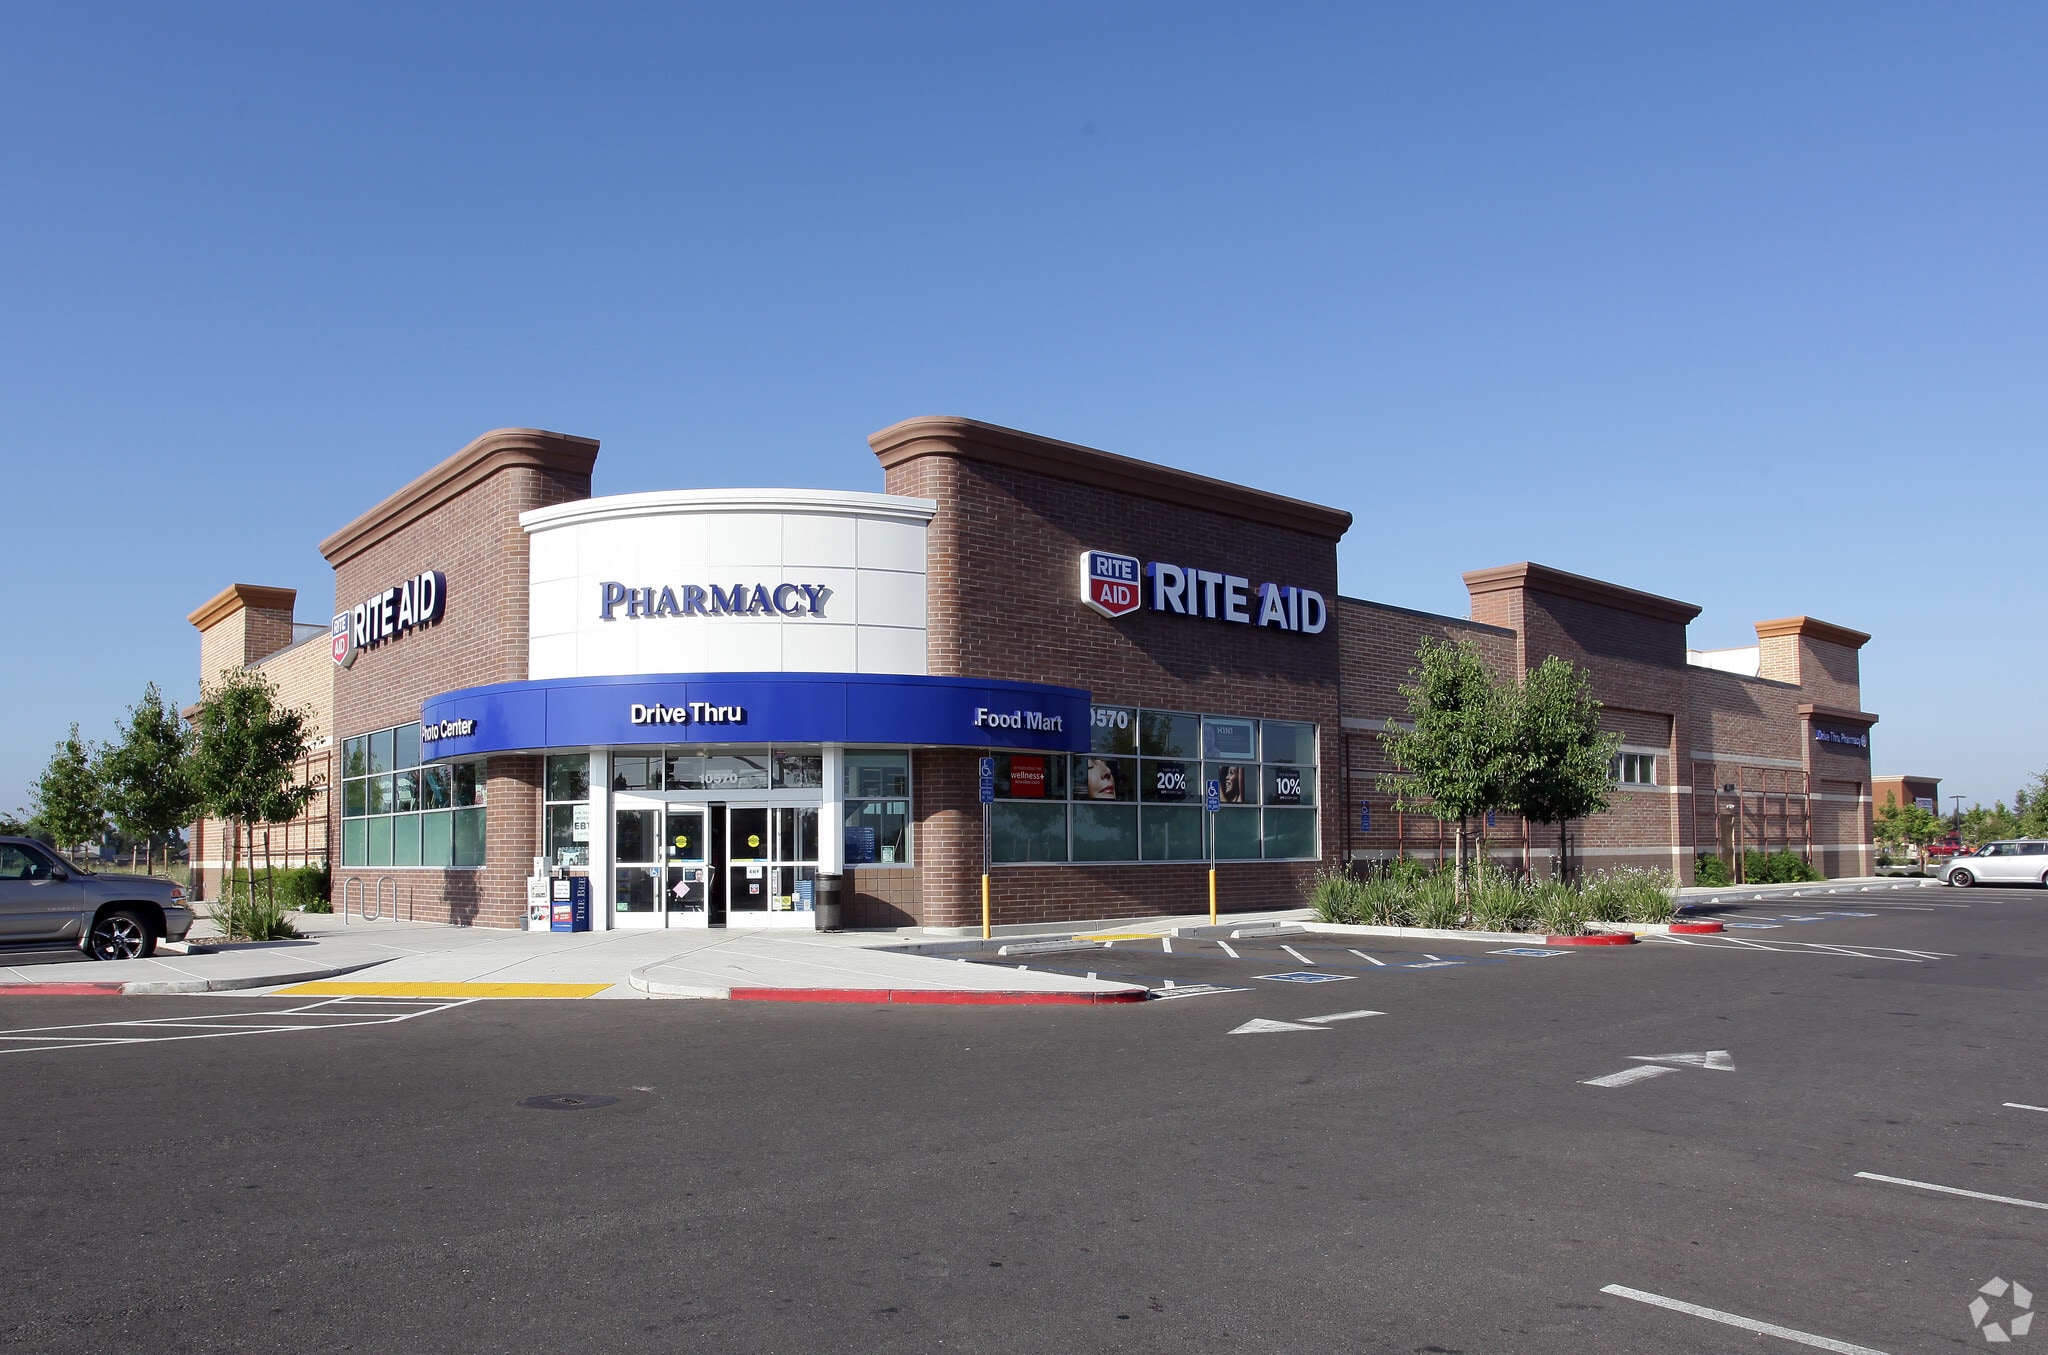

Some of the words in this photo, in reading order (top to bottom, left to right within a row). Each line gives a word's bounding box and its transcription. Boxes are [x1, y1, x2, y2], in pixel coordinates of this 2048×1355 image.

[1096, 556, 1132, 580] RITE
[598, 580, 827, 620] PHARMACY
[1100, 583, 1131, 606] AID
[1151, 562, 1250, 624] RITE
[1259, 582, 1327, 635] AID
[353, 587, 394, 649] RITE
[398, 570, 436, 630] AID
[334, 614, 347, 635] RITE
[334, 637, 346, 657] AID
[631, 703, 686, 724] Drive
[689, 702, 742, 722] Thru
[976, 707, 1022, 730] Food
[1025, 710, 1063, 733] Mart
[440, 718, 473, 738] Center
[1816, 729, 1830, 741] Drive
[1830, 731, 1840, 743] Thru
[1840, 733, 1861, 747] Pharmacy
[699, 772, 738, 784] 10570
[1010, 770, 1045, 780] wellness+
[1157, 772, 1186, 790] 20%
[1276, 778, 1300, 795] 10%
[577, 877, 586, 897] BEE
[577, 899, 585, 921] THE
